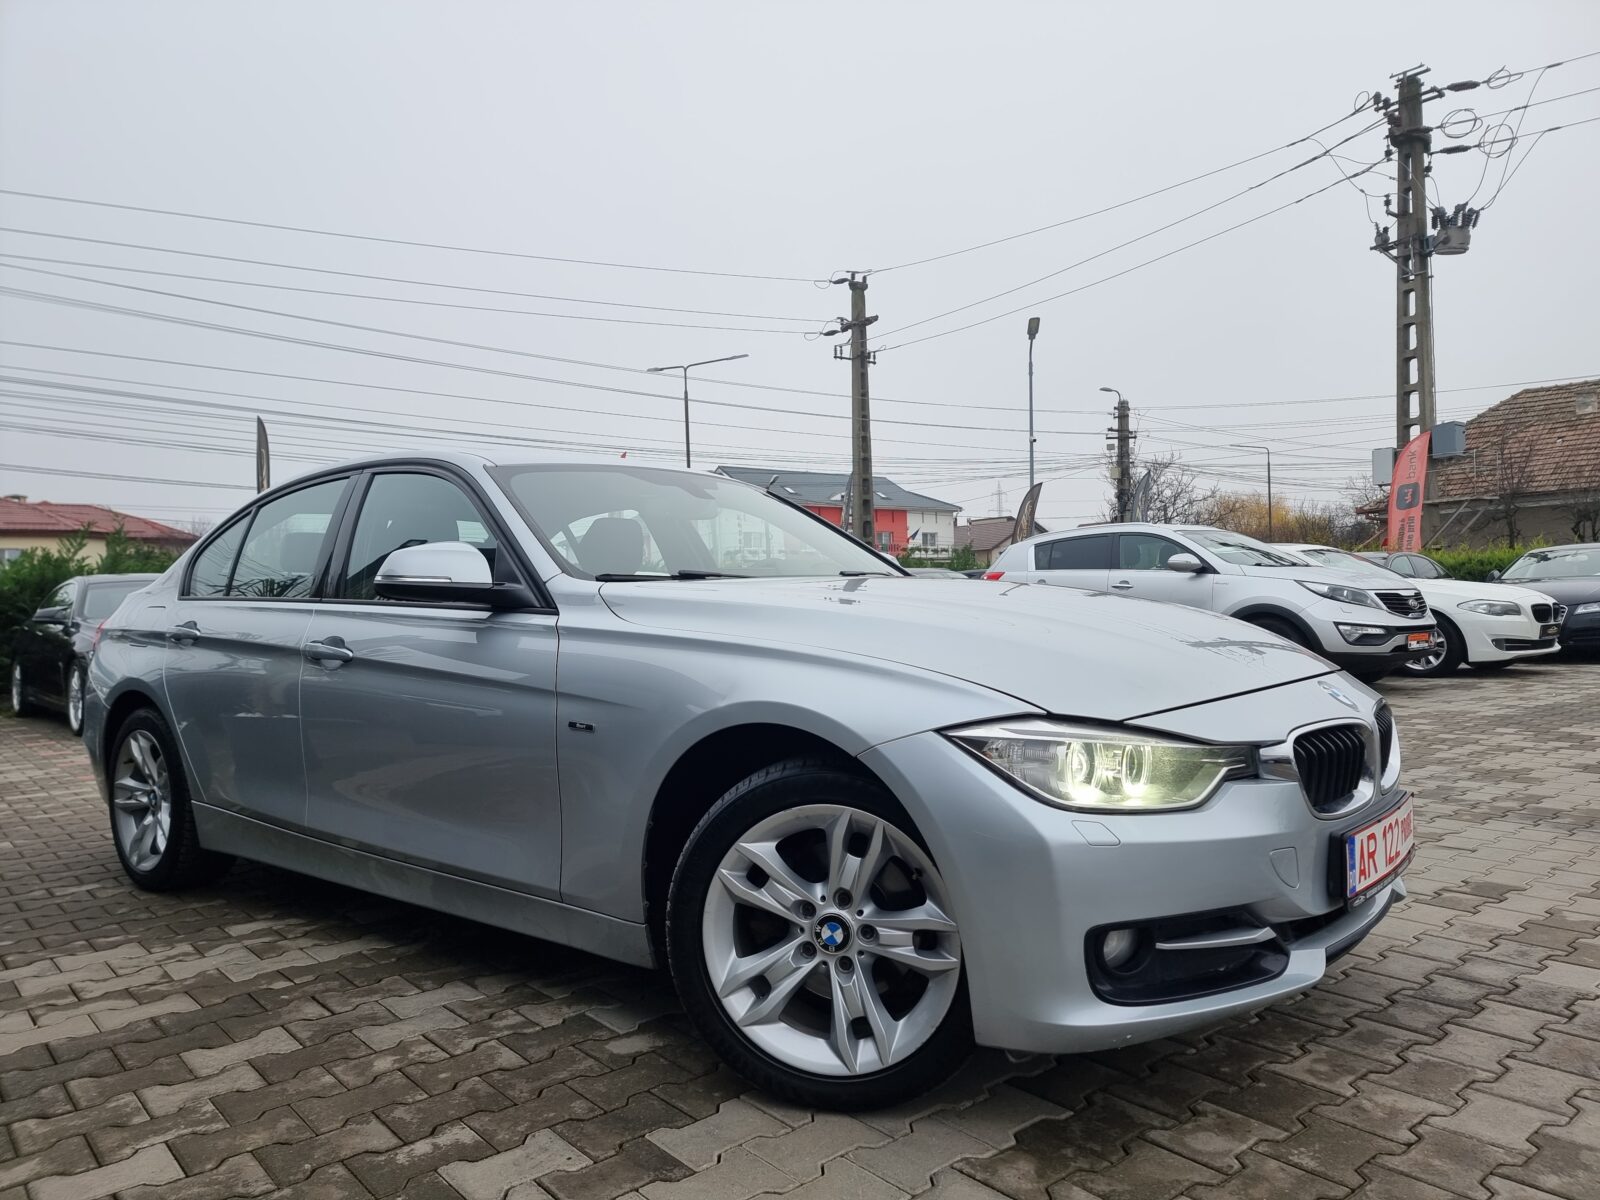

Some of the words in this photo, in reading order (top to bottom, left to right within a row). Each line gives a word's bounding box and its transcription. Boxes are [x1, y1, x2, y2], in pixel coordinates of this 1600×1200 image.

[1406, 449, 1417, 479] bank
[1359, 832, 1378, 883] AR
[1382, 818, 1400, 867] 122
[815, 924, 835, 952] BMW
